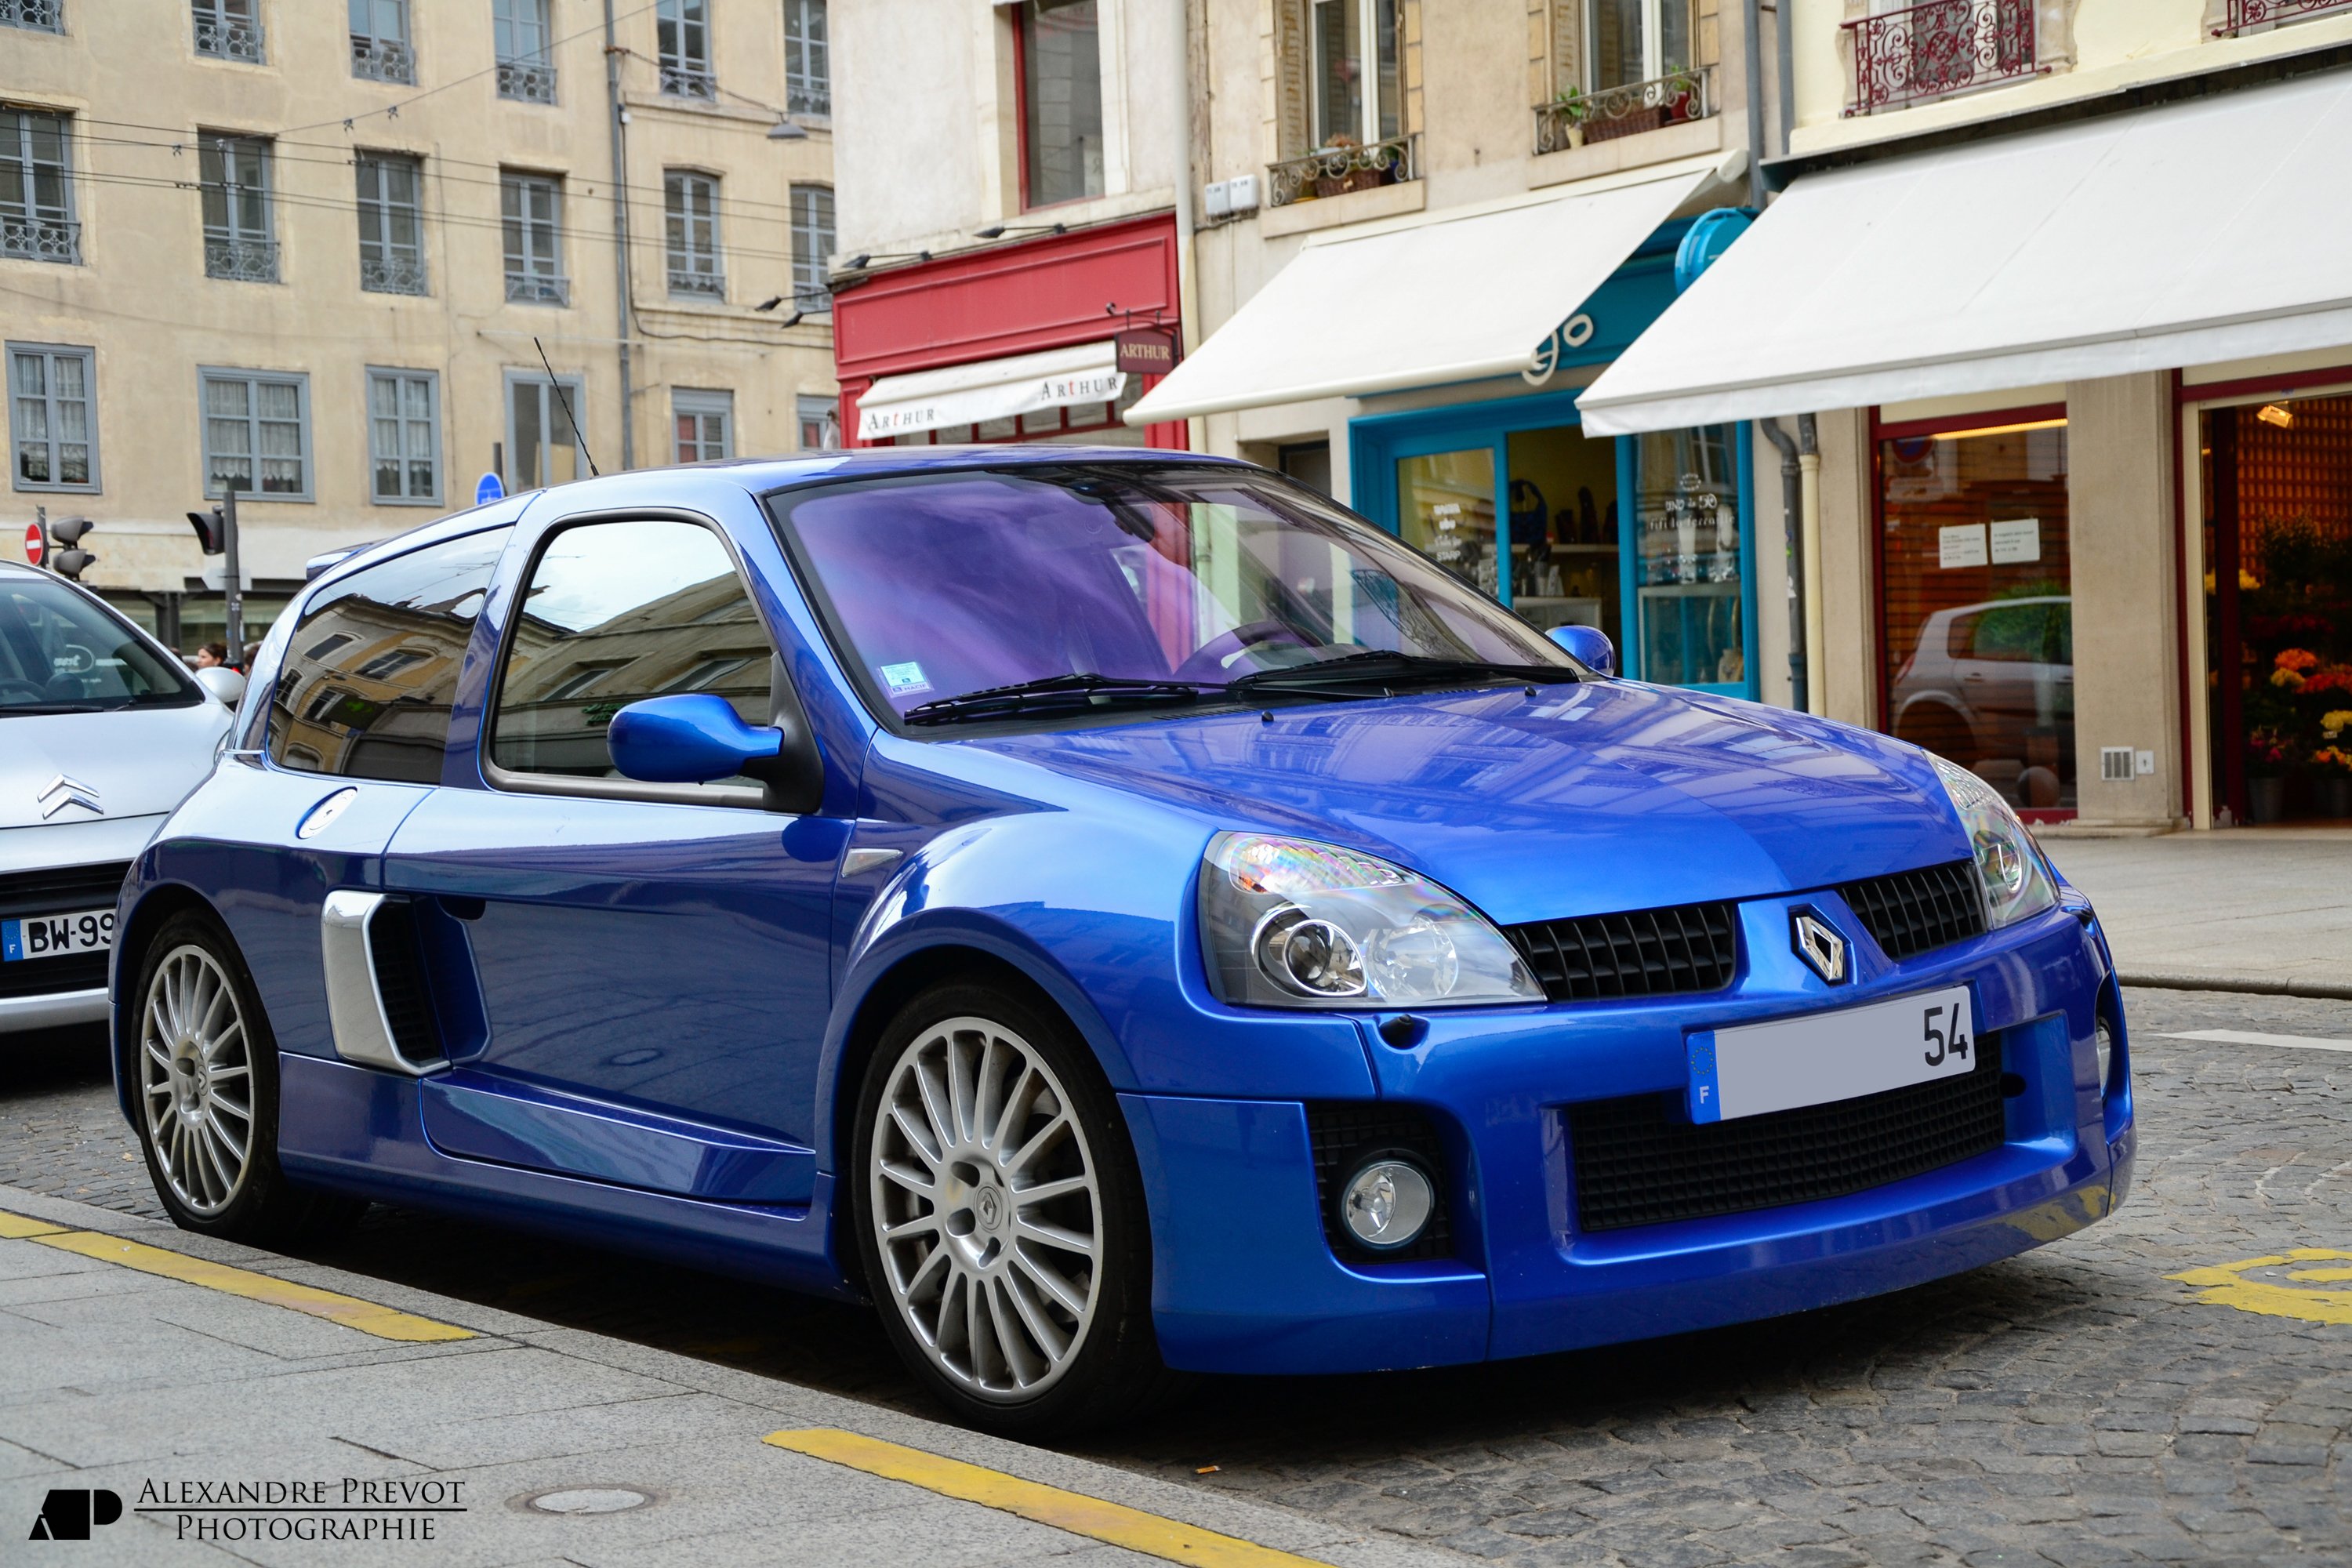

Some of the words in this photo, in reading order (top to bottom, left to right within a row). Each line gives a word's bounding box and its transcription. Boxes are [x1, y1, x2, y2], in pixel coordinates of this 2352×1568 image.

[1120, 343, 1171, 361] ARTHUR
[9, 944, 16, 954] F
[1924, 1002, 1969, 1067] 54
[1699, 1085, 1710, 1105] F
